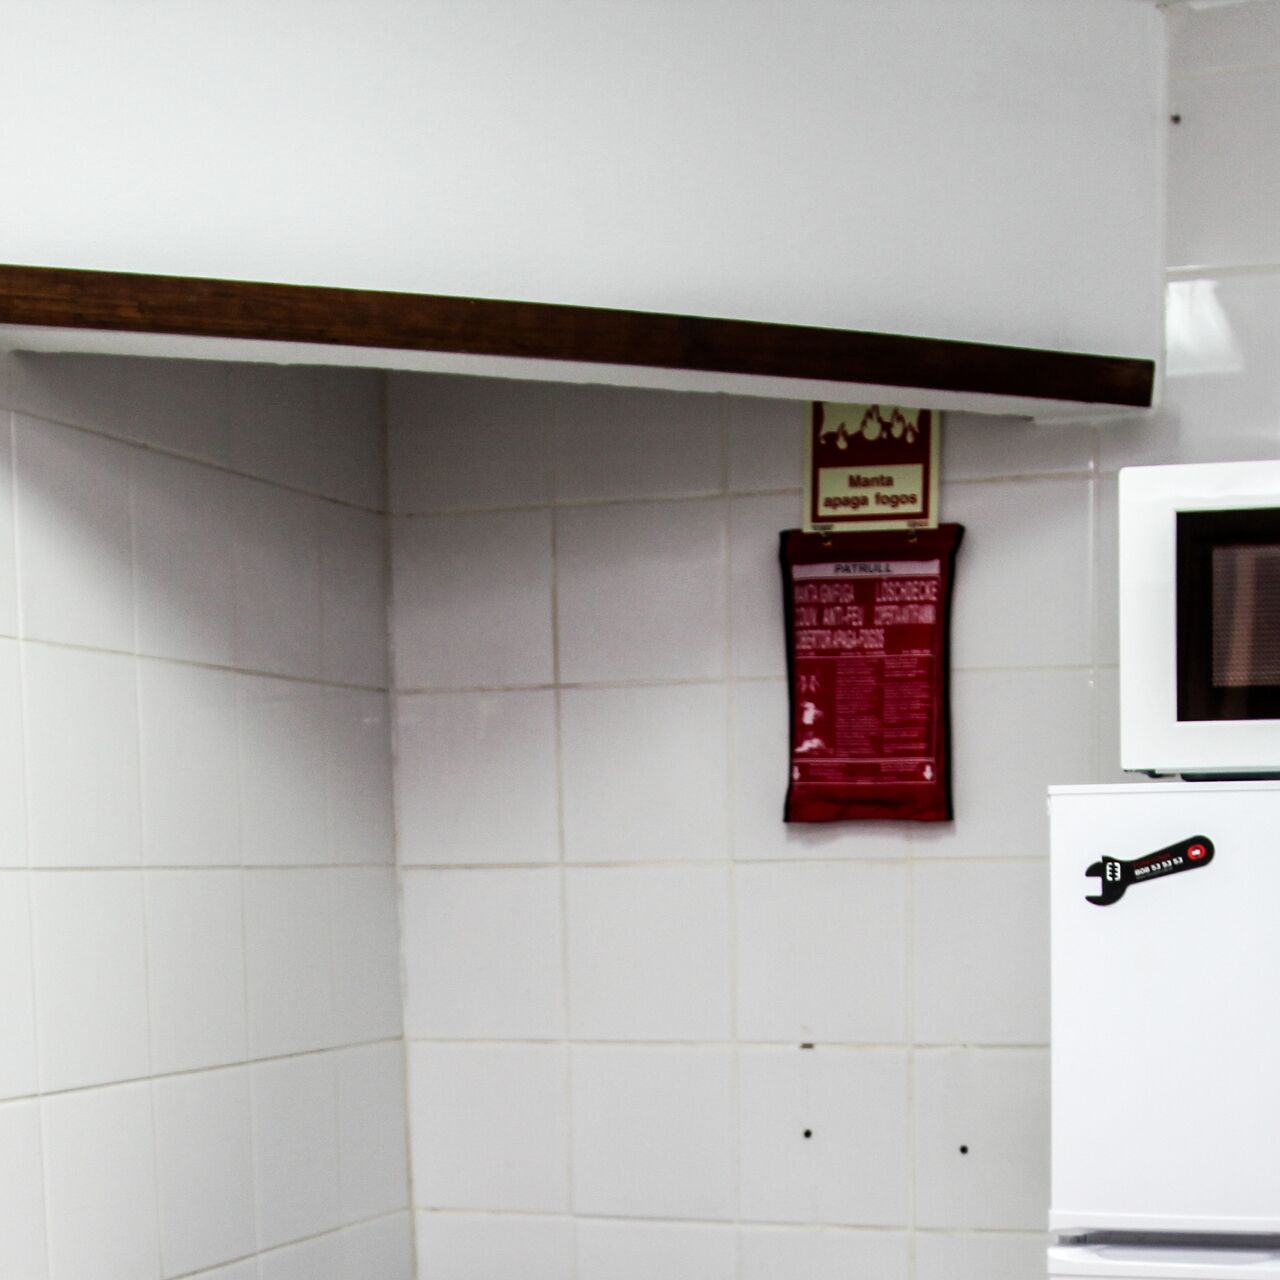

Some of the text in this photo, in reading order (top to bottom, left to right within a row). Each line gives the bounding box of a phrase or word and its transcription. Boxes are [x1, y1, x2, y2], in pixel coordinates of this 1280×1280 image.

[849, 474, 893, 488] Manta
[824, 491, 918, 509] apaga fogos
